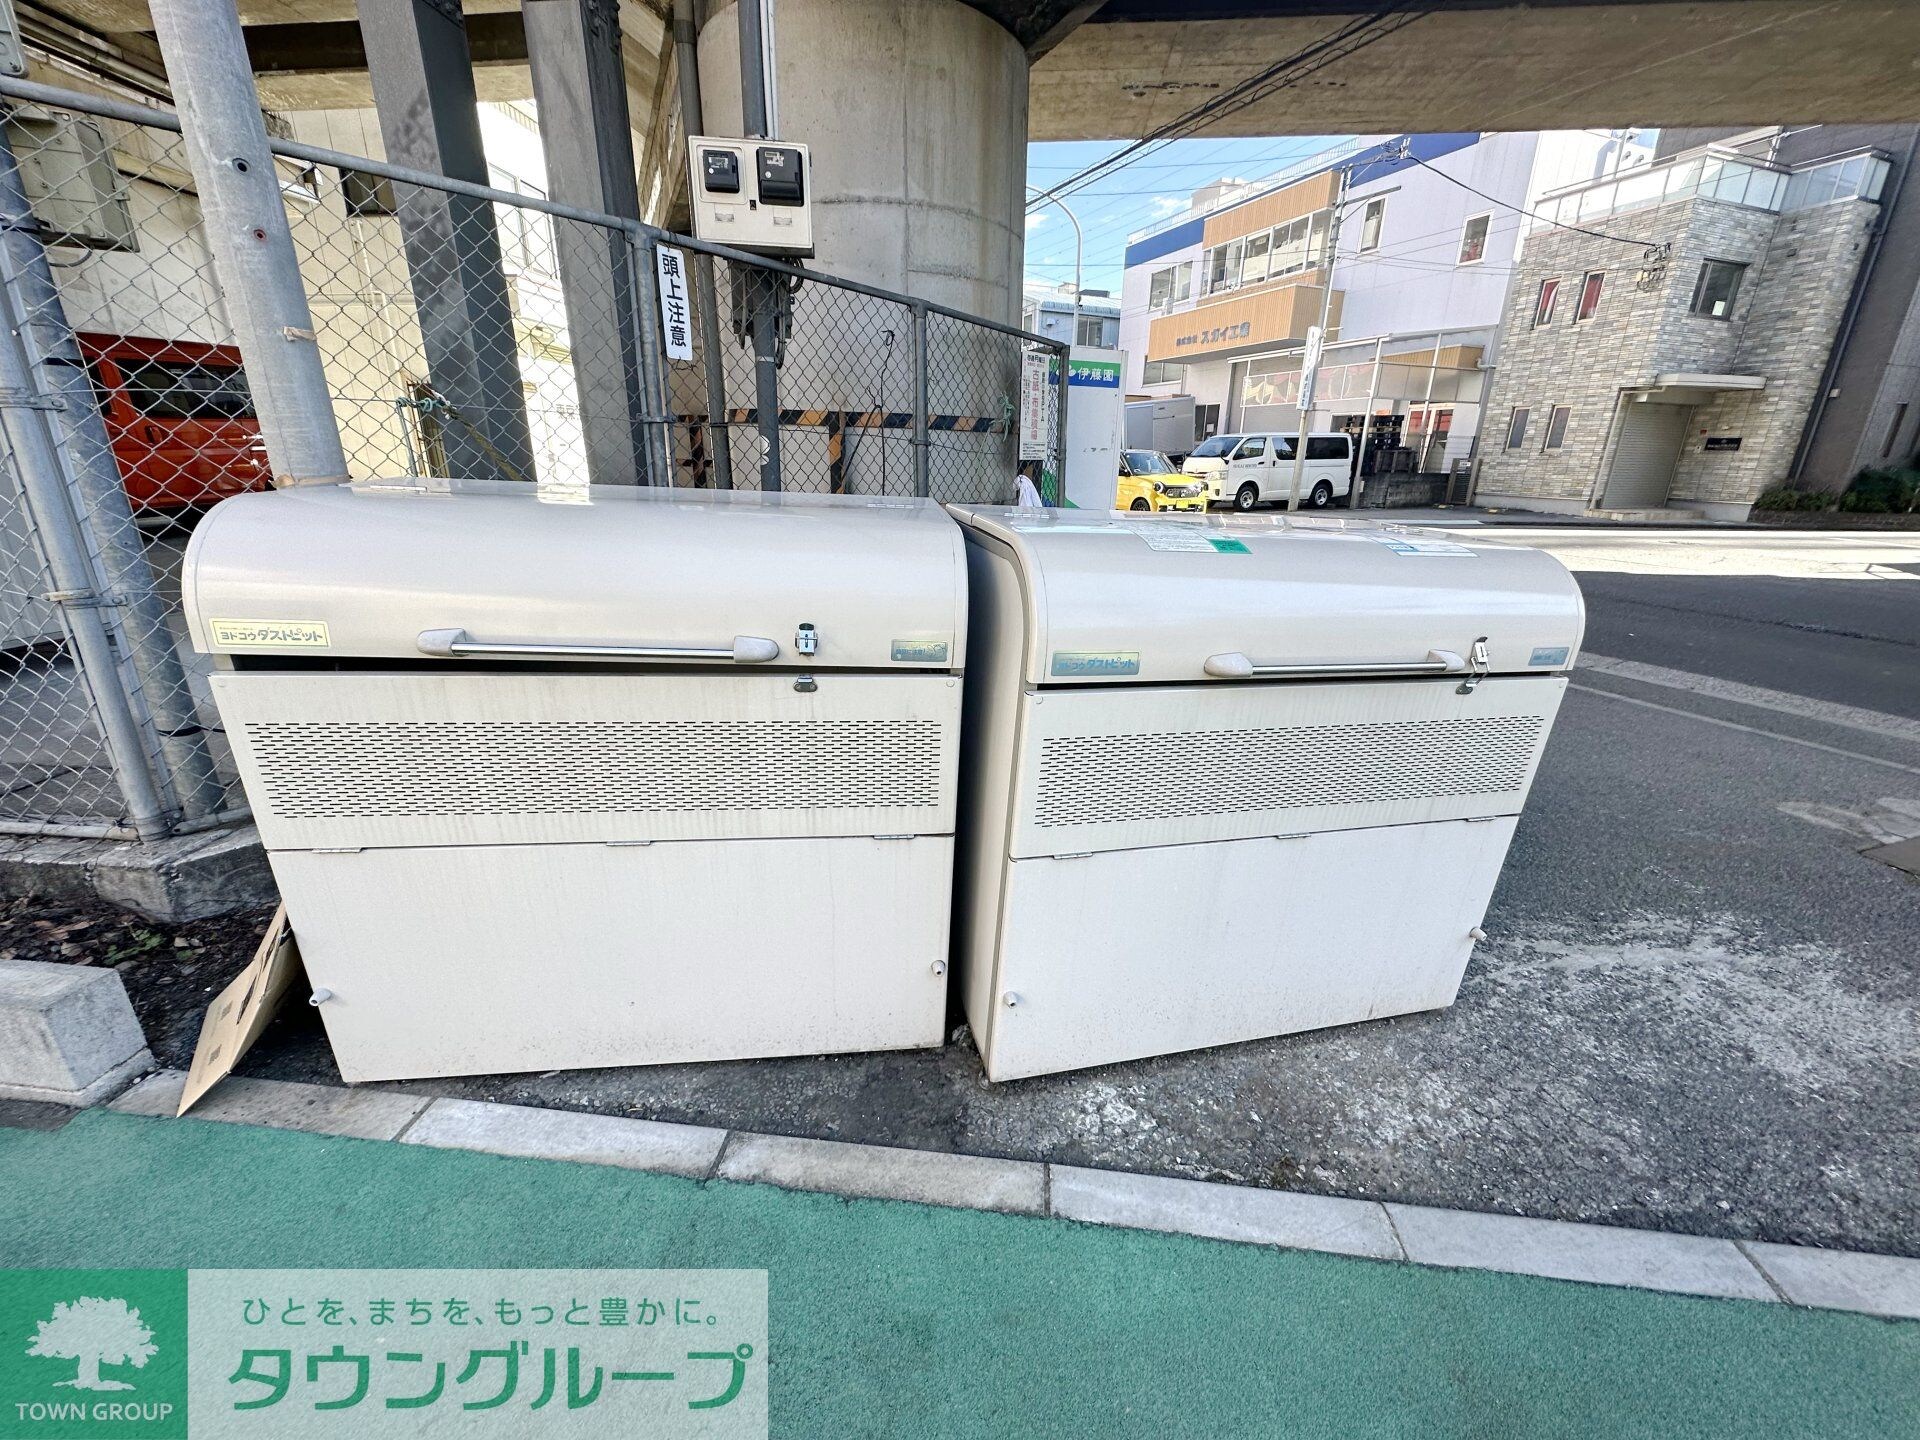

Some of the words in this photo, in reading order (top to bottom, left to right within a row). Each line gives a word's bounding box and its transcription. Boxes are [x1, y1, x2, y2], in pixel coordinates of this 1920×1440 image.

[662, 254, 687, 348] 頭上注意
[1077, 367, 1114, 382] 伊藤園
[555, 404, 580, 420] 東京
